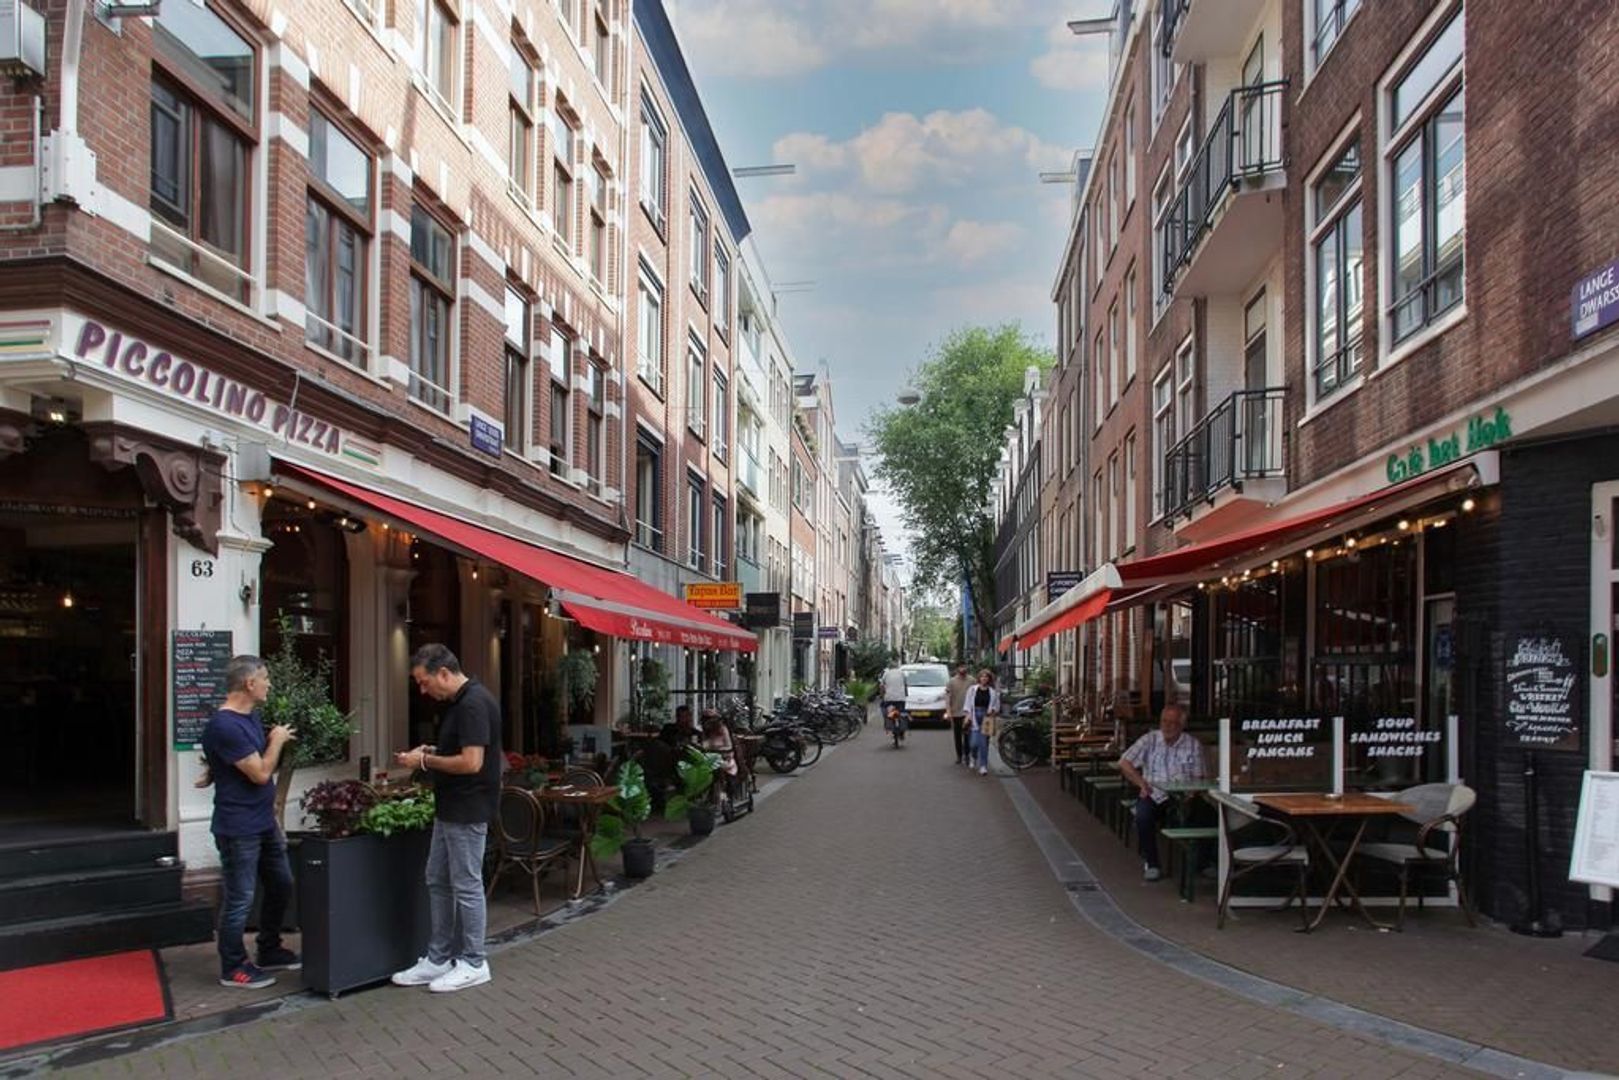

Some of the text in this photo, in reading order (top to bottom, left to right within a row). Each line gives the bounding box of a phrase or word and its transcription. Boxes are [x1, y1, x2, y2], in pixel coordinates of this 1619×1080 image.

[1581, 266, 1614, 300] LANGE
[75, 320, 341, 455] PICCOLINO PIZZA
[191, 560, 214, 577] 63
[1242, 718, 1320, 730] BREAKFAST
[1377, 717, 1415, 729] SOUP
[1257, 733, 1304, 743] LUNCH
[1350, 731, 1441, 743] SANDWICHES
[1247, 746, 1315, 758] PANCAKE
[1367, 745, 1424, 757] SNACKS
